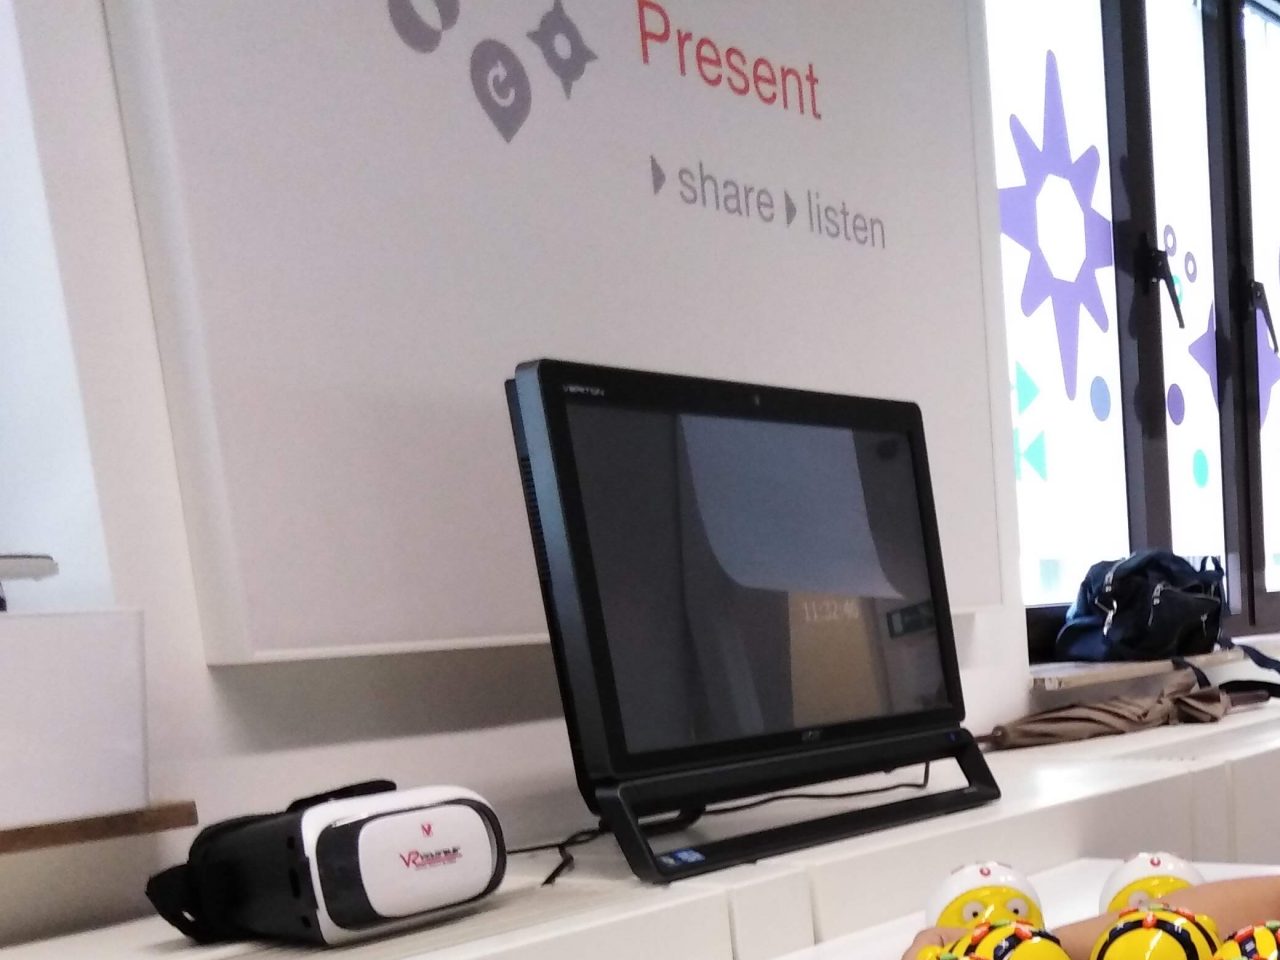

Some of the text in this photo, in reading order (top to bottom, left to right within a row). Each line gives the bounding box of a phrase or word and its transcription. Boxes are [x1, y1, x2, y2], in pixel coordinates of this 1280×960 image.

[637, 0, 823, 120] Present
[677, 162, 887, 249] share listen
